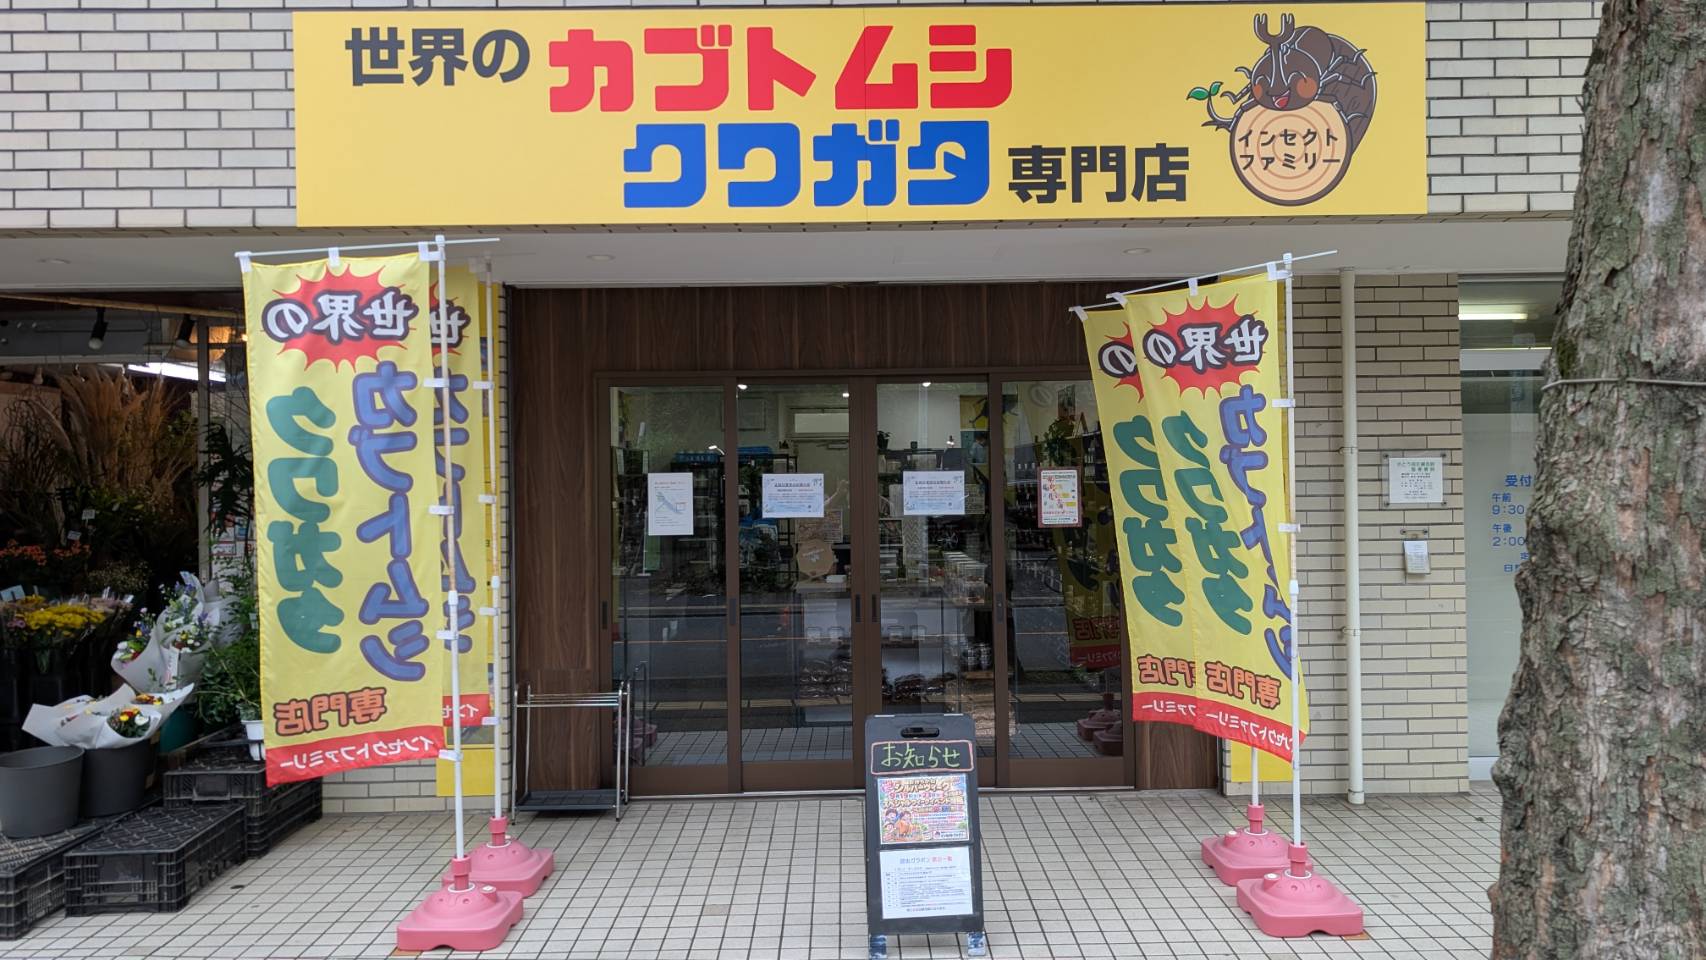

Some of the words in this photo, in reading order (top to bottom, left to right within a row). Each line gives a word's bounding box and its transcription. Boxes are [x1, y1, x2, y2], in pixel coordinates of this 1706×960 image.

[345, 27, 531, 86] 世界の
[549, 24, 1012, 112] カブトムシ
[1238, 128, 1339, 148] インセクト
[623, 119, 990, 208] クワガタ
[1008, 143, 1189, 203] 専門店
[1239, 153, 1341, 171] ファミリー
[1505, 474, 1533, 487] 受付
[1492, 505, 1524, 515] 9:30
[1493, 537, 1526, 547] 2:00
[881, 742, 961, 768] お知らせ
